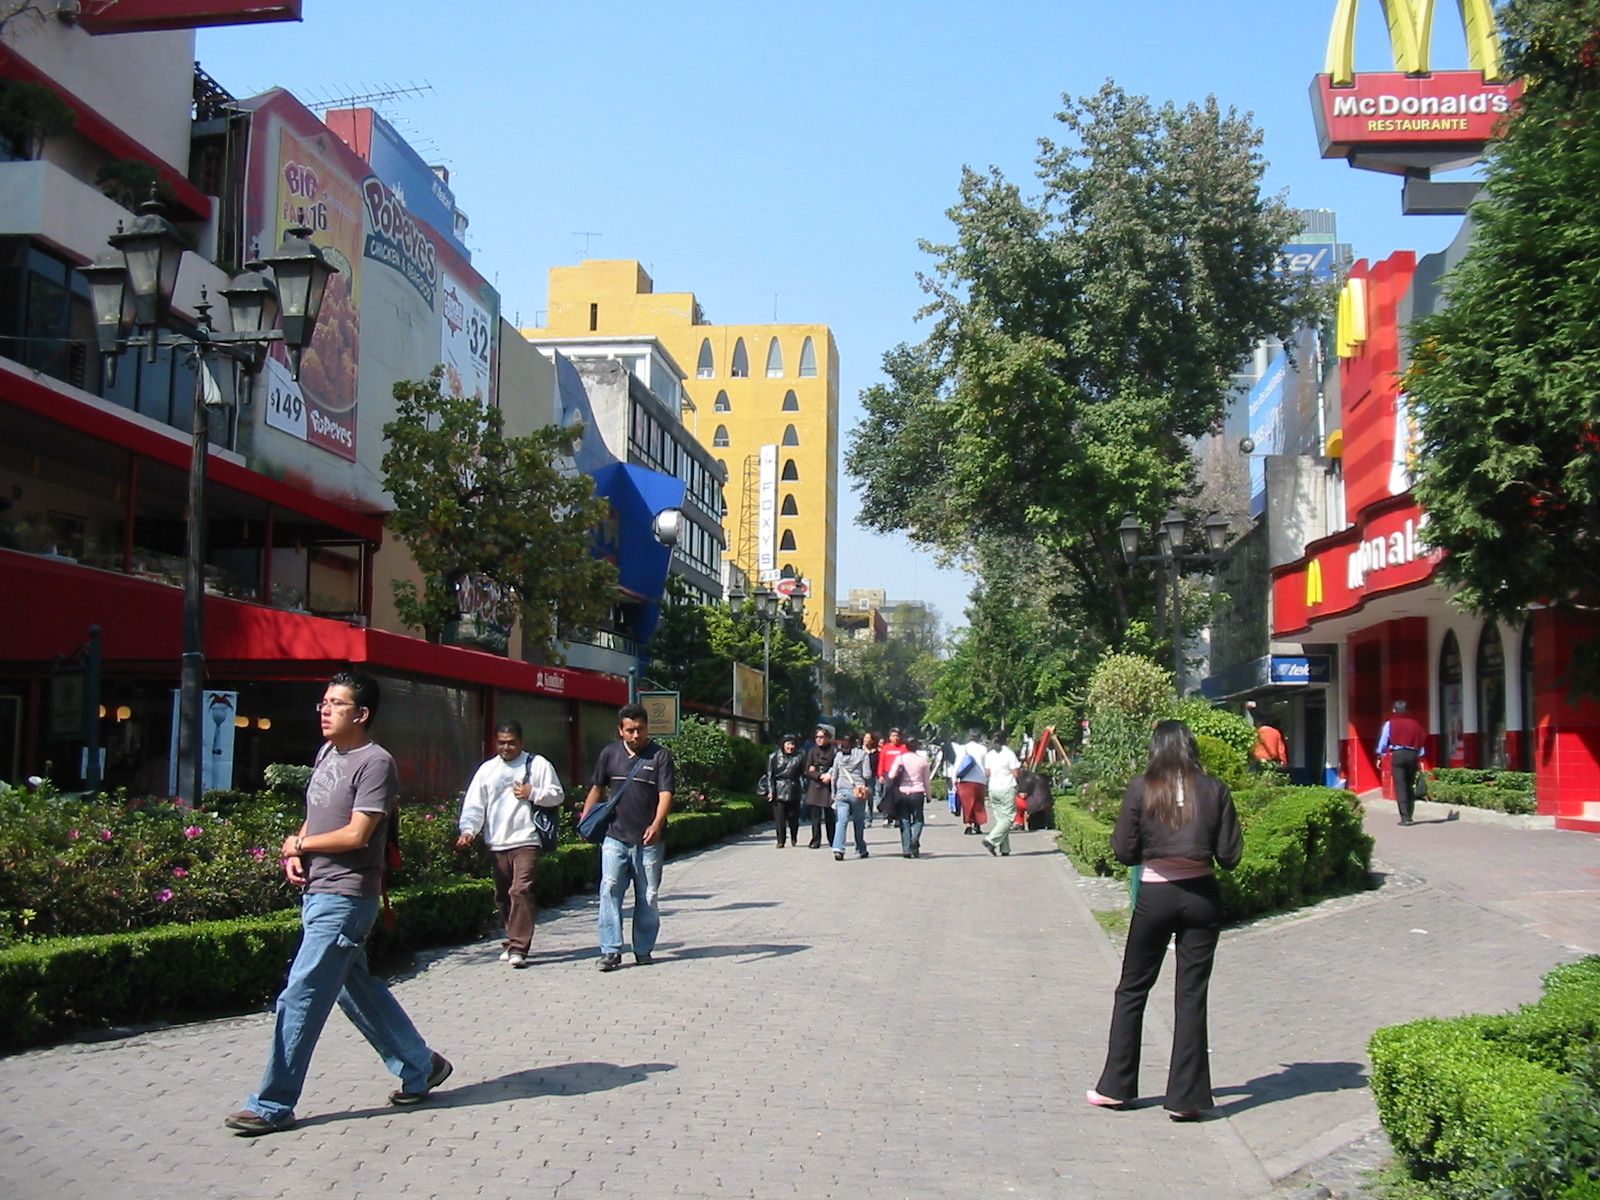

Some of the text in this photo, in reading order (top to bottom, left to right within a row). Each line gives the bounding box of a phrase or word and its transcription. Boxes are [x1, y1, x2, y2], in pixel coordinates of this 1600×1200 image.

[1333, 91, 1509, 117] McDonald's
[1368, 117, 1468, 131] RESTAURANTE
[282, 161, 319, 200] BIG
[270, 387, 303, 422] $149
